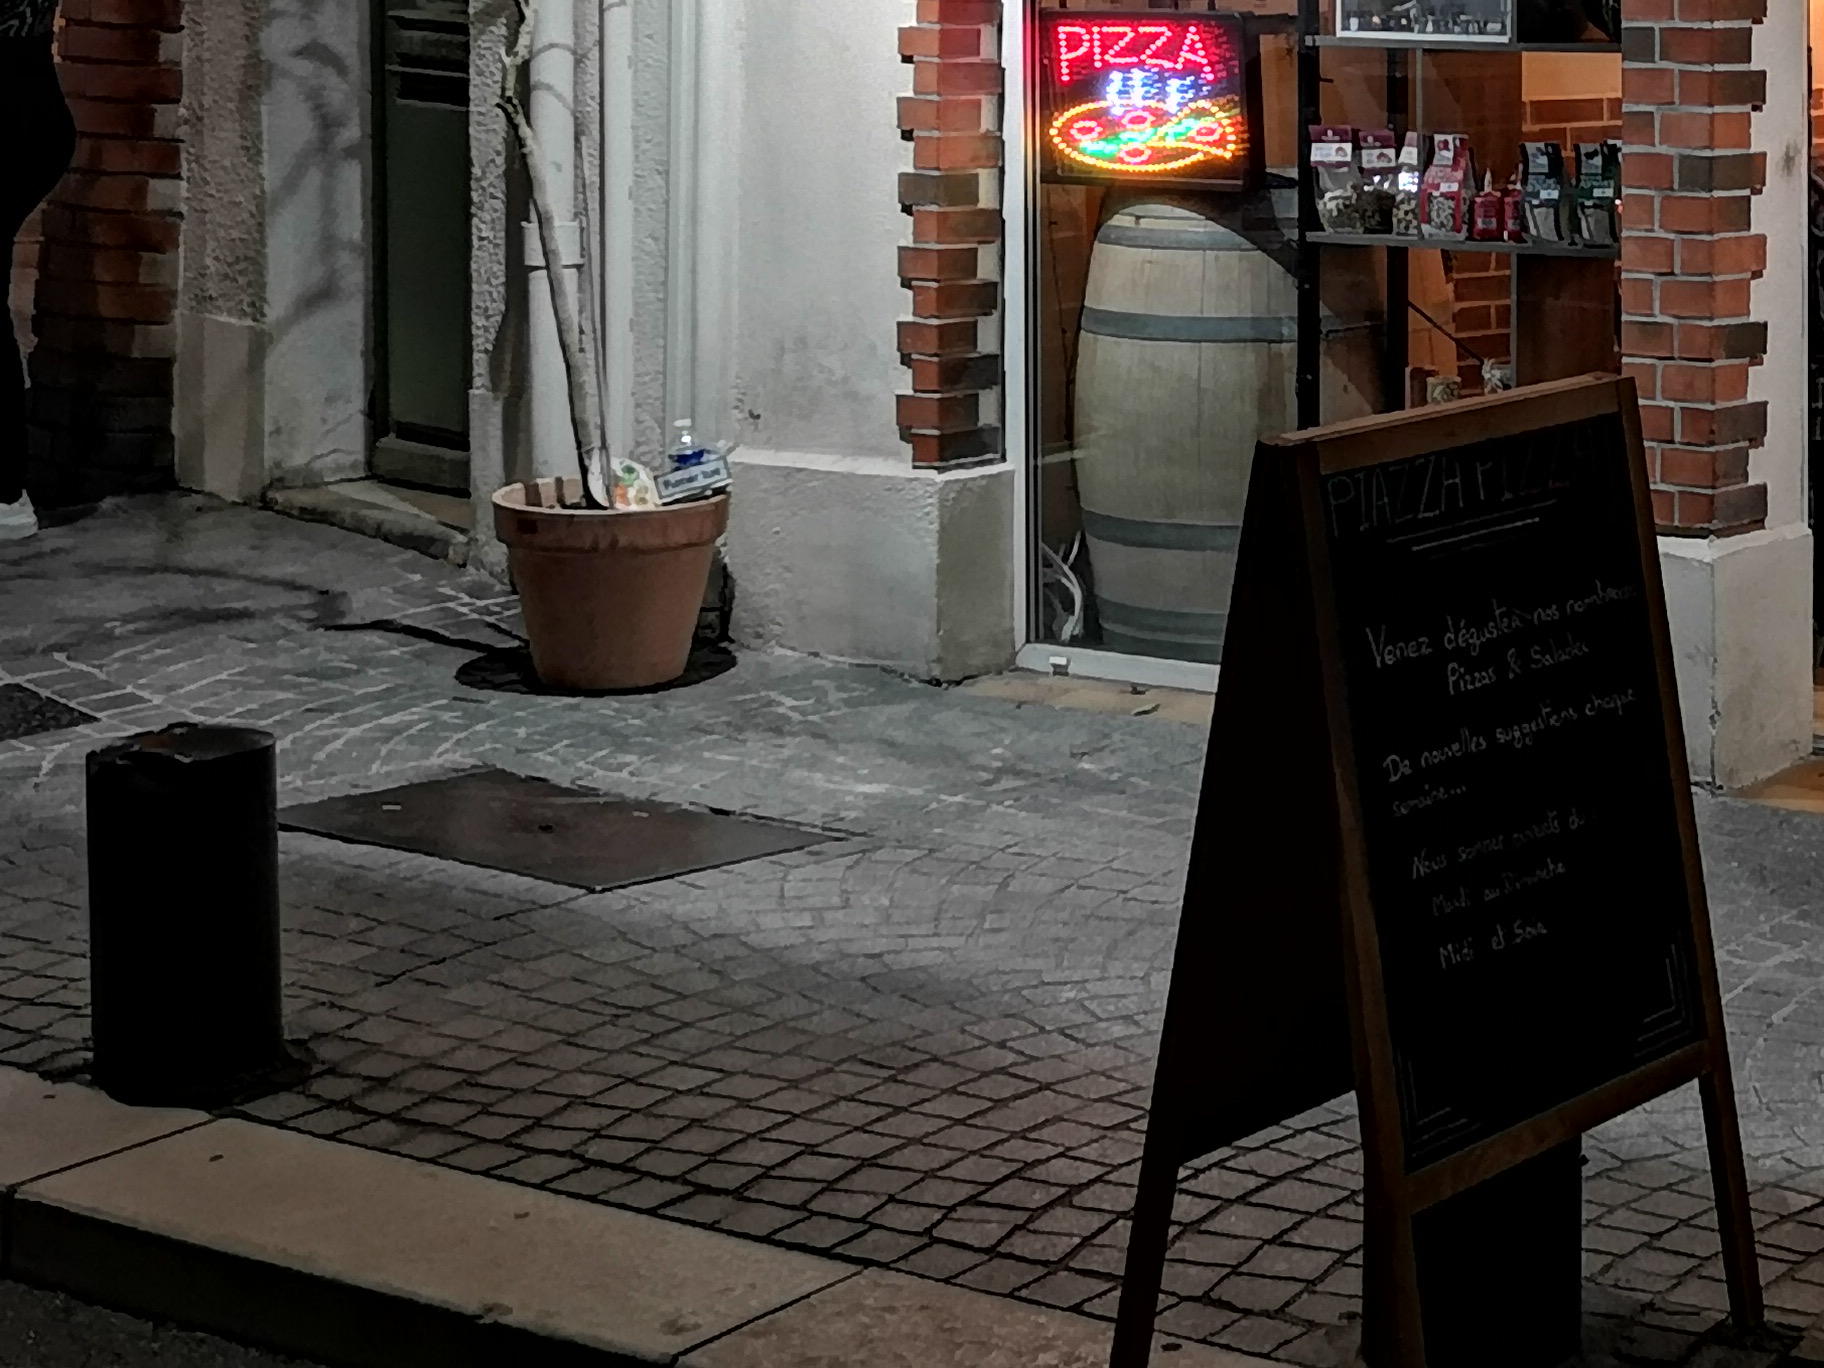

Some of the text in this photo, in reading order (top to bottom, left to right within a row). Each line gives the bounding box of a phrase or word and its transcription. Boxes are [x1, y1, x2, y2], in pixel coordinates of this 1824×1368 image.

[1057, 25, 1215, 82] PIZZA
[1327, 455, 1464, 539] PIAZZA
[1365, 624, 1434, 669] Venez
[1534, 604, 1561, 625] nos
[1447, 661, 1497, 696] Pizzas
[1506, 647, 1522, 681] &
[1382, 754, 1413, 783] De
[1421, 725, 1488, 770] nouvelles
[1412, 846, 1448, 880] Nous
[1438, 935, 1475, 972] Midi
[1490, 922, 1509, 951] et
